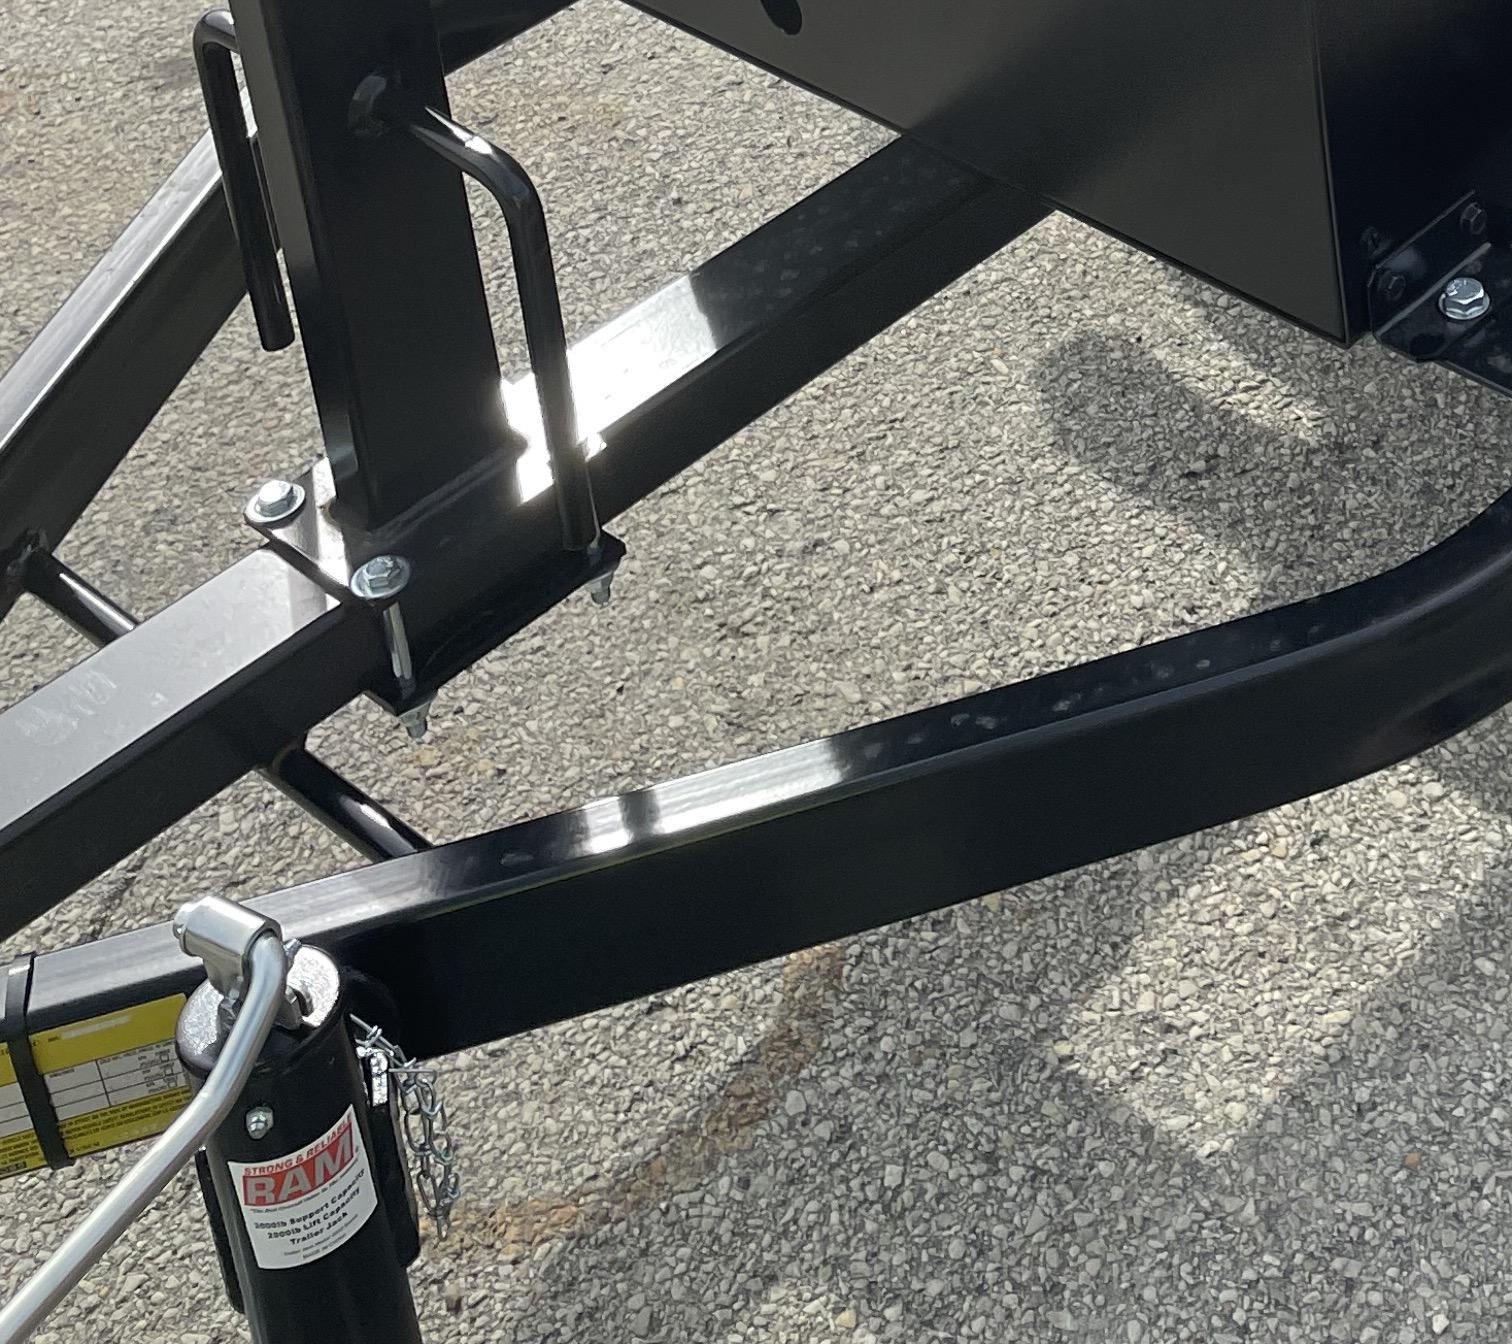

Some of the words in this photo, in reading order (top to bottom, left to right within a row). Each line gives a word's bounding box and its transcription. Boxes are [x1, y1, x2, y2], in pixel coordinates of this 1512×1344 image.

[244, 1158, 293, 1176] STRONG
[296, 1153, 303, 1164] &
[246, 1131, 352, 1205] RAM
[289, 1202, 330, 1225] Support
[303, 1217, 321, 1230] Lift
[323, 1186, 360, 1220] Capacity
[289, 1228, 324, 1245] Trailer
[326, 1212, 348, 1230] Jack
